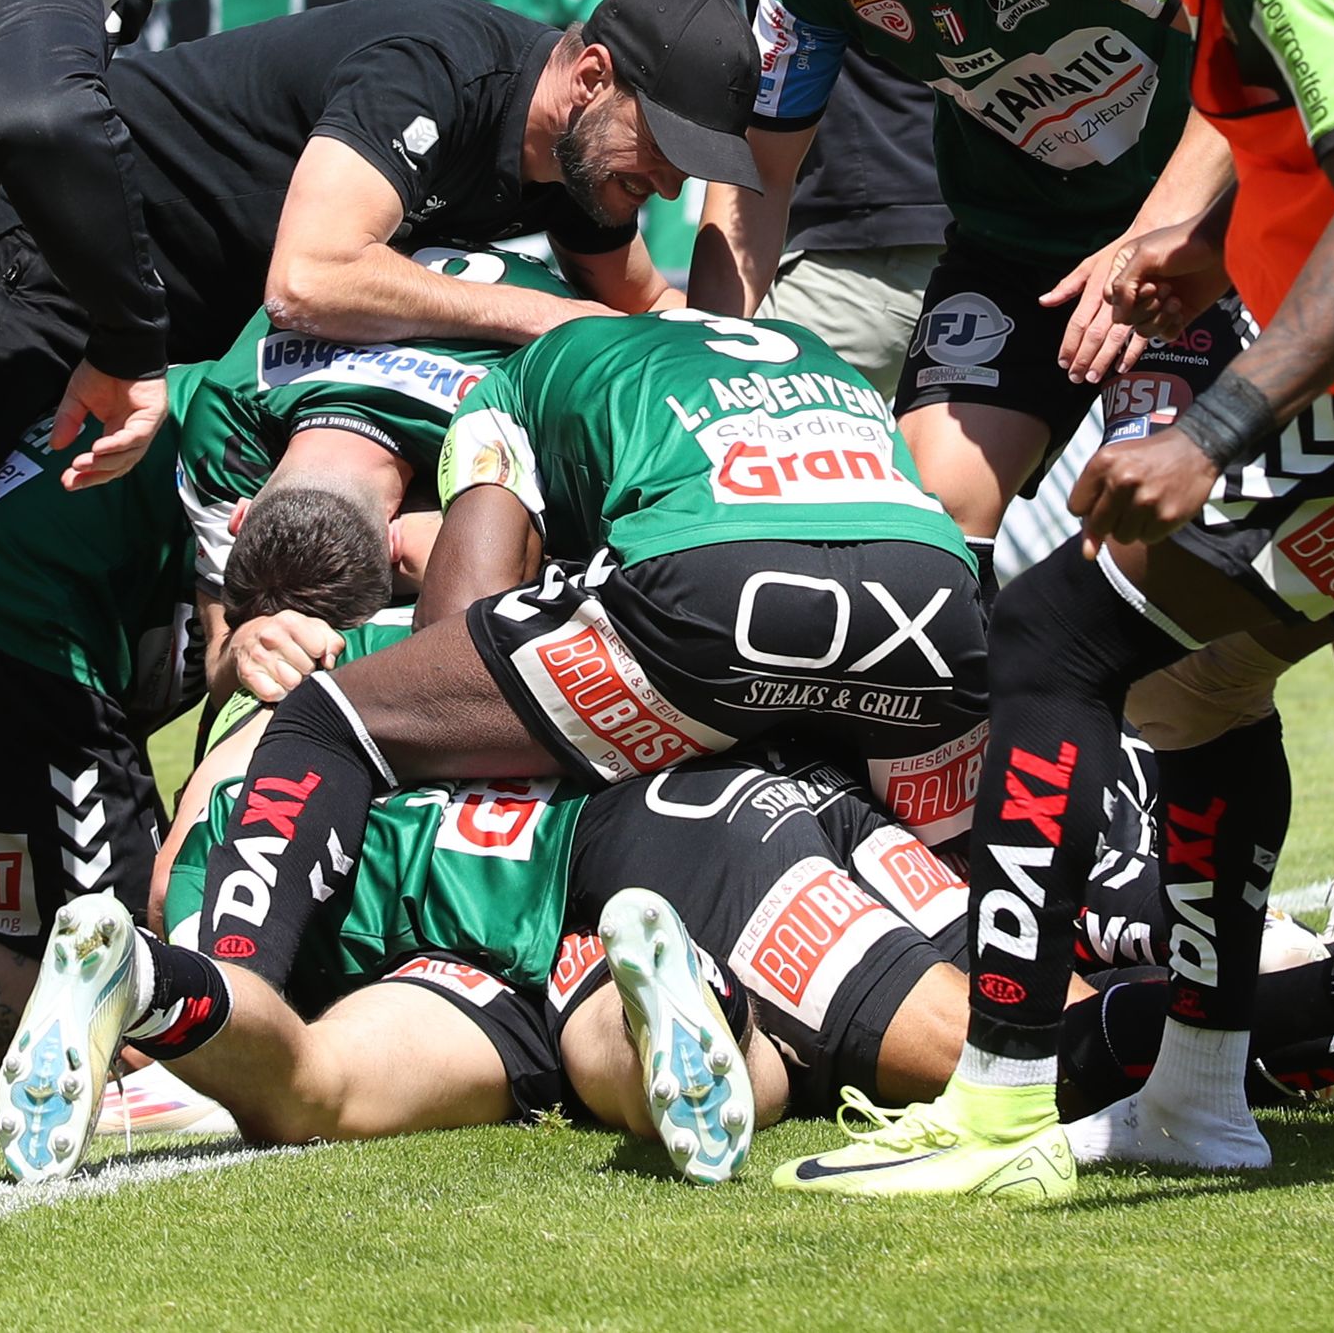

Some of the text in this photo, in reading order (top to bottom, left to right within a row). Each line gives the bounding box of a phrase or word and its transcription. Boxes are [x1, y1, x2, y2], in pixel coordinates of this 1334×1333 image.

[956, 52, 997, 75] BWT
[658, 307, 802, 365] 3
[665, 394, 712, 433] L.
[717, 440, 904, 497] Gran
[734, 570, 955, 679] OX
[593, 617, 636, 675] FLIESEN
[641, 688, 685, 724] STEIN
[743, 679, 923, 721] STEAKS & GRILL
[889, 744, 953, 775] FLIESEN
[893, 751, 984, 821] BAUB
[219, 937, 254, 955] KIA
[737, 895, 783, 961] FLIESEN
